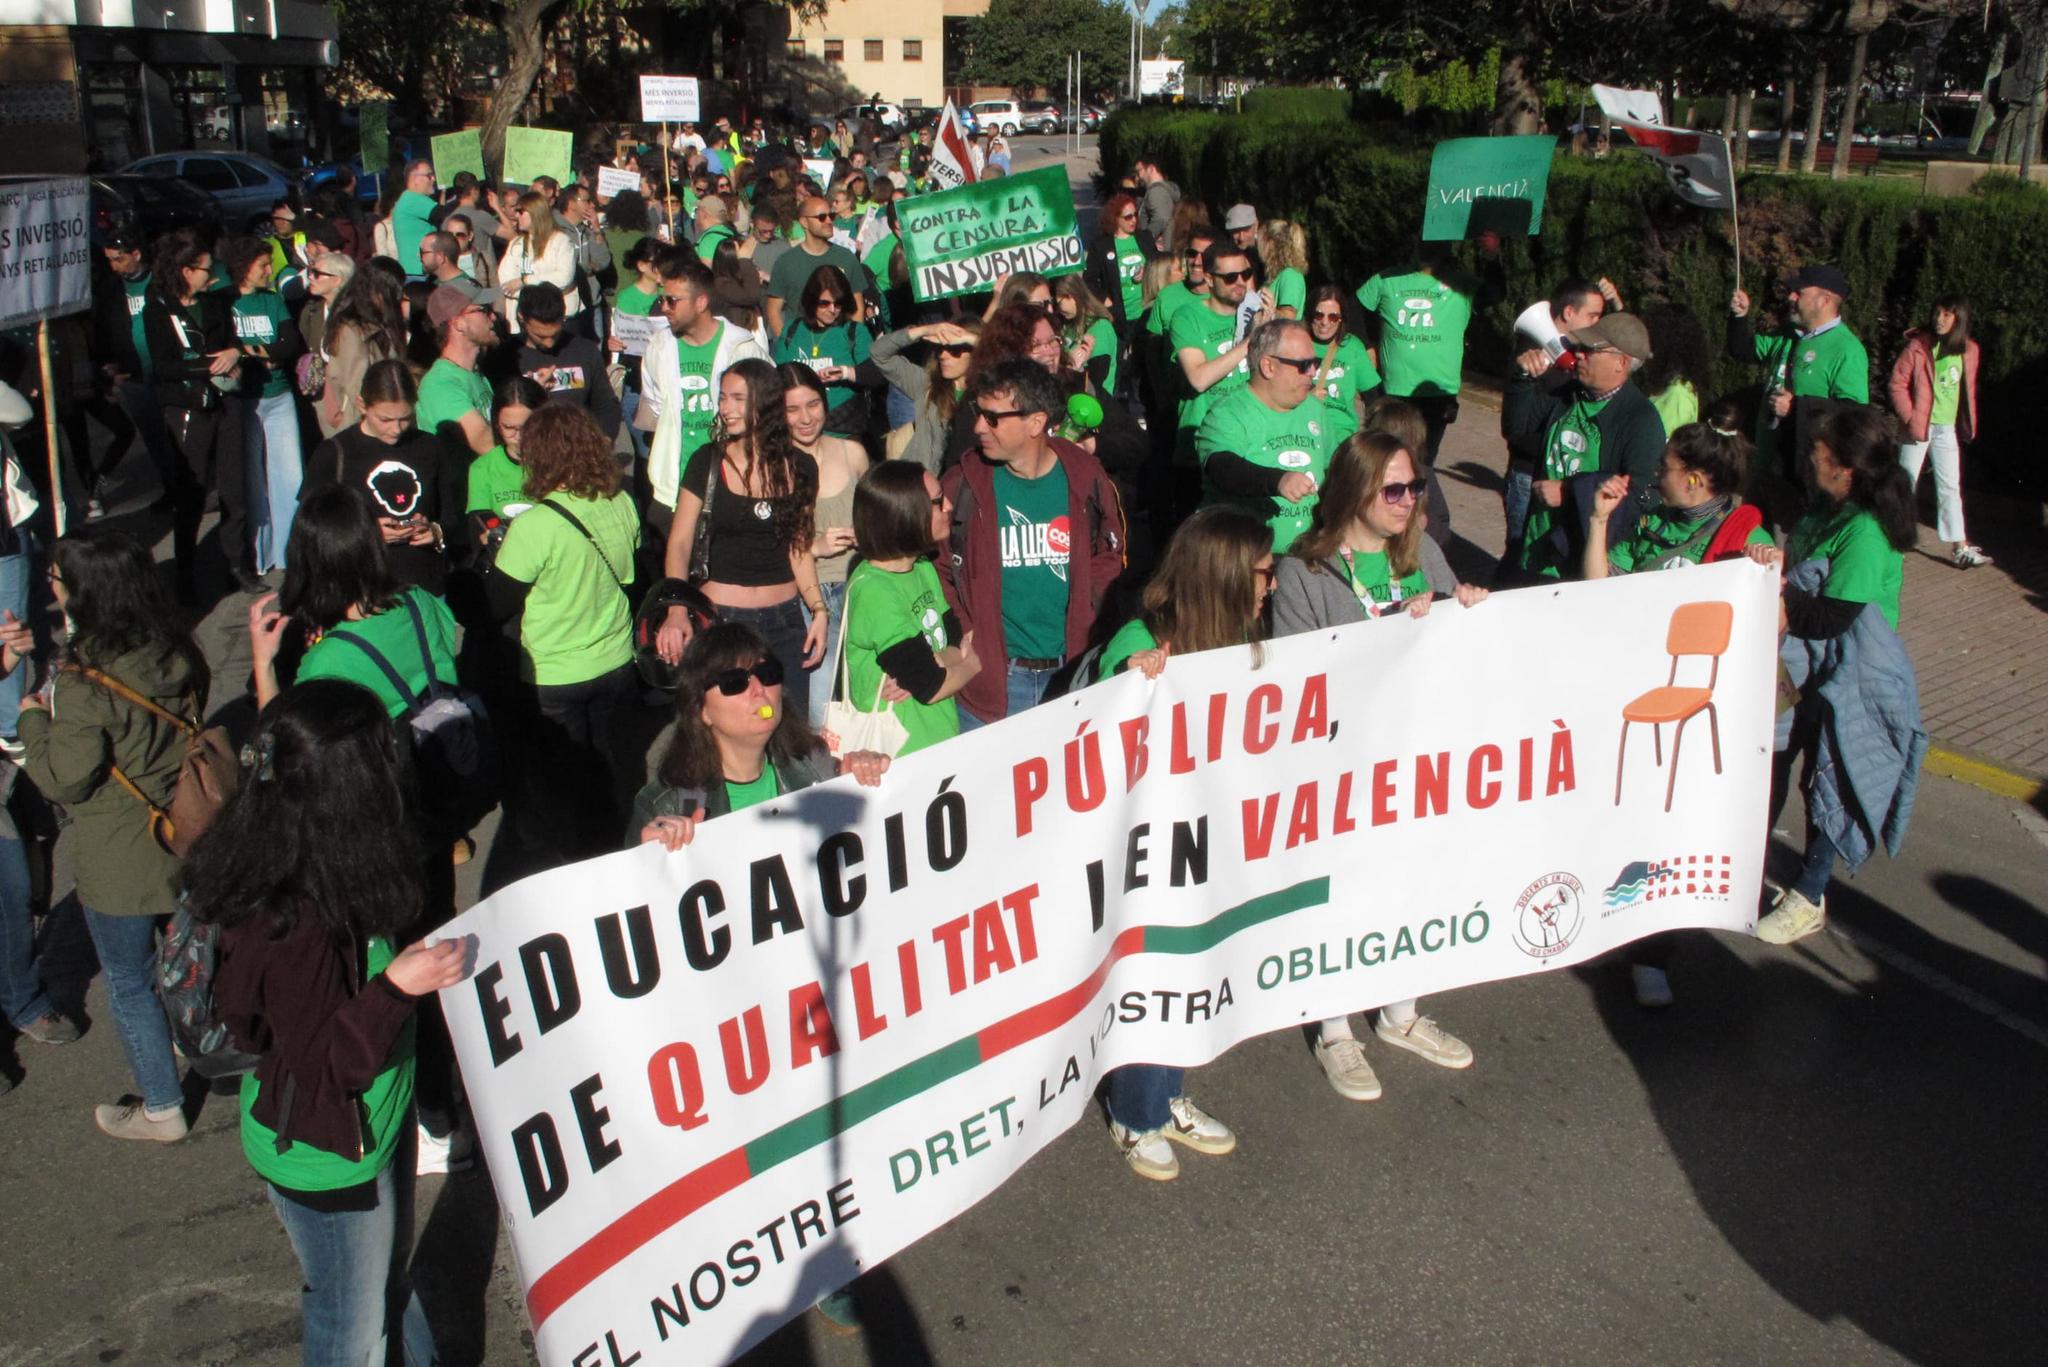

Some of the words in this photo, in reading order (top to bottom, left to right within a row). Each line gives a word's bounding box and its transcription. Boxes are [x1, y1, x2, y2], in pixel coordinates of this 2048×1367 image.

[16, 212, 88, 247] INVERSIÓ,
[911, 206, 982, 234] CONTRA
[1008, 194, 1034, 212] LA
[24, 249, 88, 275] RETALLADES
[1001, 525, 1020, 559] LA
[1002, 559, 1022, 568] NO
[474, 775, 968, 1069] EDUCACIÓ
[1012, 673, 1339, 838] PÚBLICA,
[1518, 877, 1549, 908] DOCENTS
[511, 1073, 623, 1219] DE
[647, 883, 1040, 1131] QUALITAT
[1086, 858, 1105, 934] I
[1123, 814, 1209, 896] EN
[1242, 718, 1577, 861] VALENCIÀ
[1530, 947, 1541, 956] IES
[650, 1178, 861, 1342] NOSTRE
[889, 1096, 1024, 1193] DRET,
[1039, 1055, 1080, 1111] LA
[1256, 901, 1491, 991] OBLIGACIÓ
